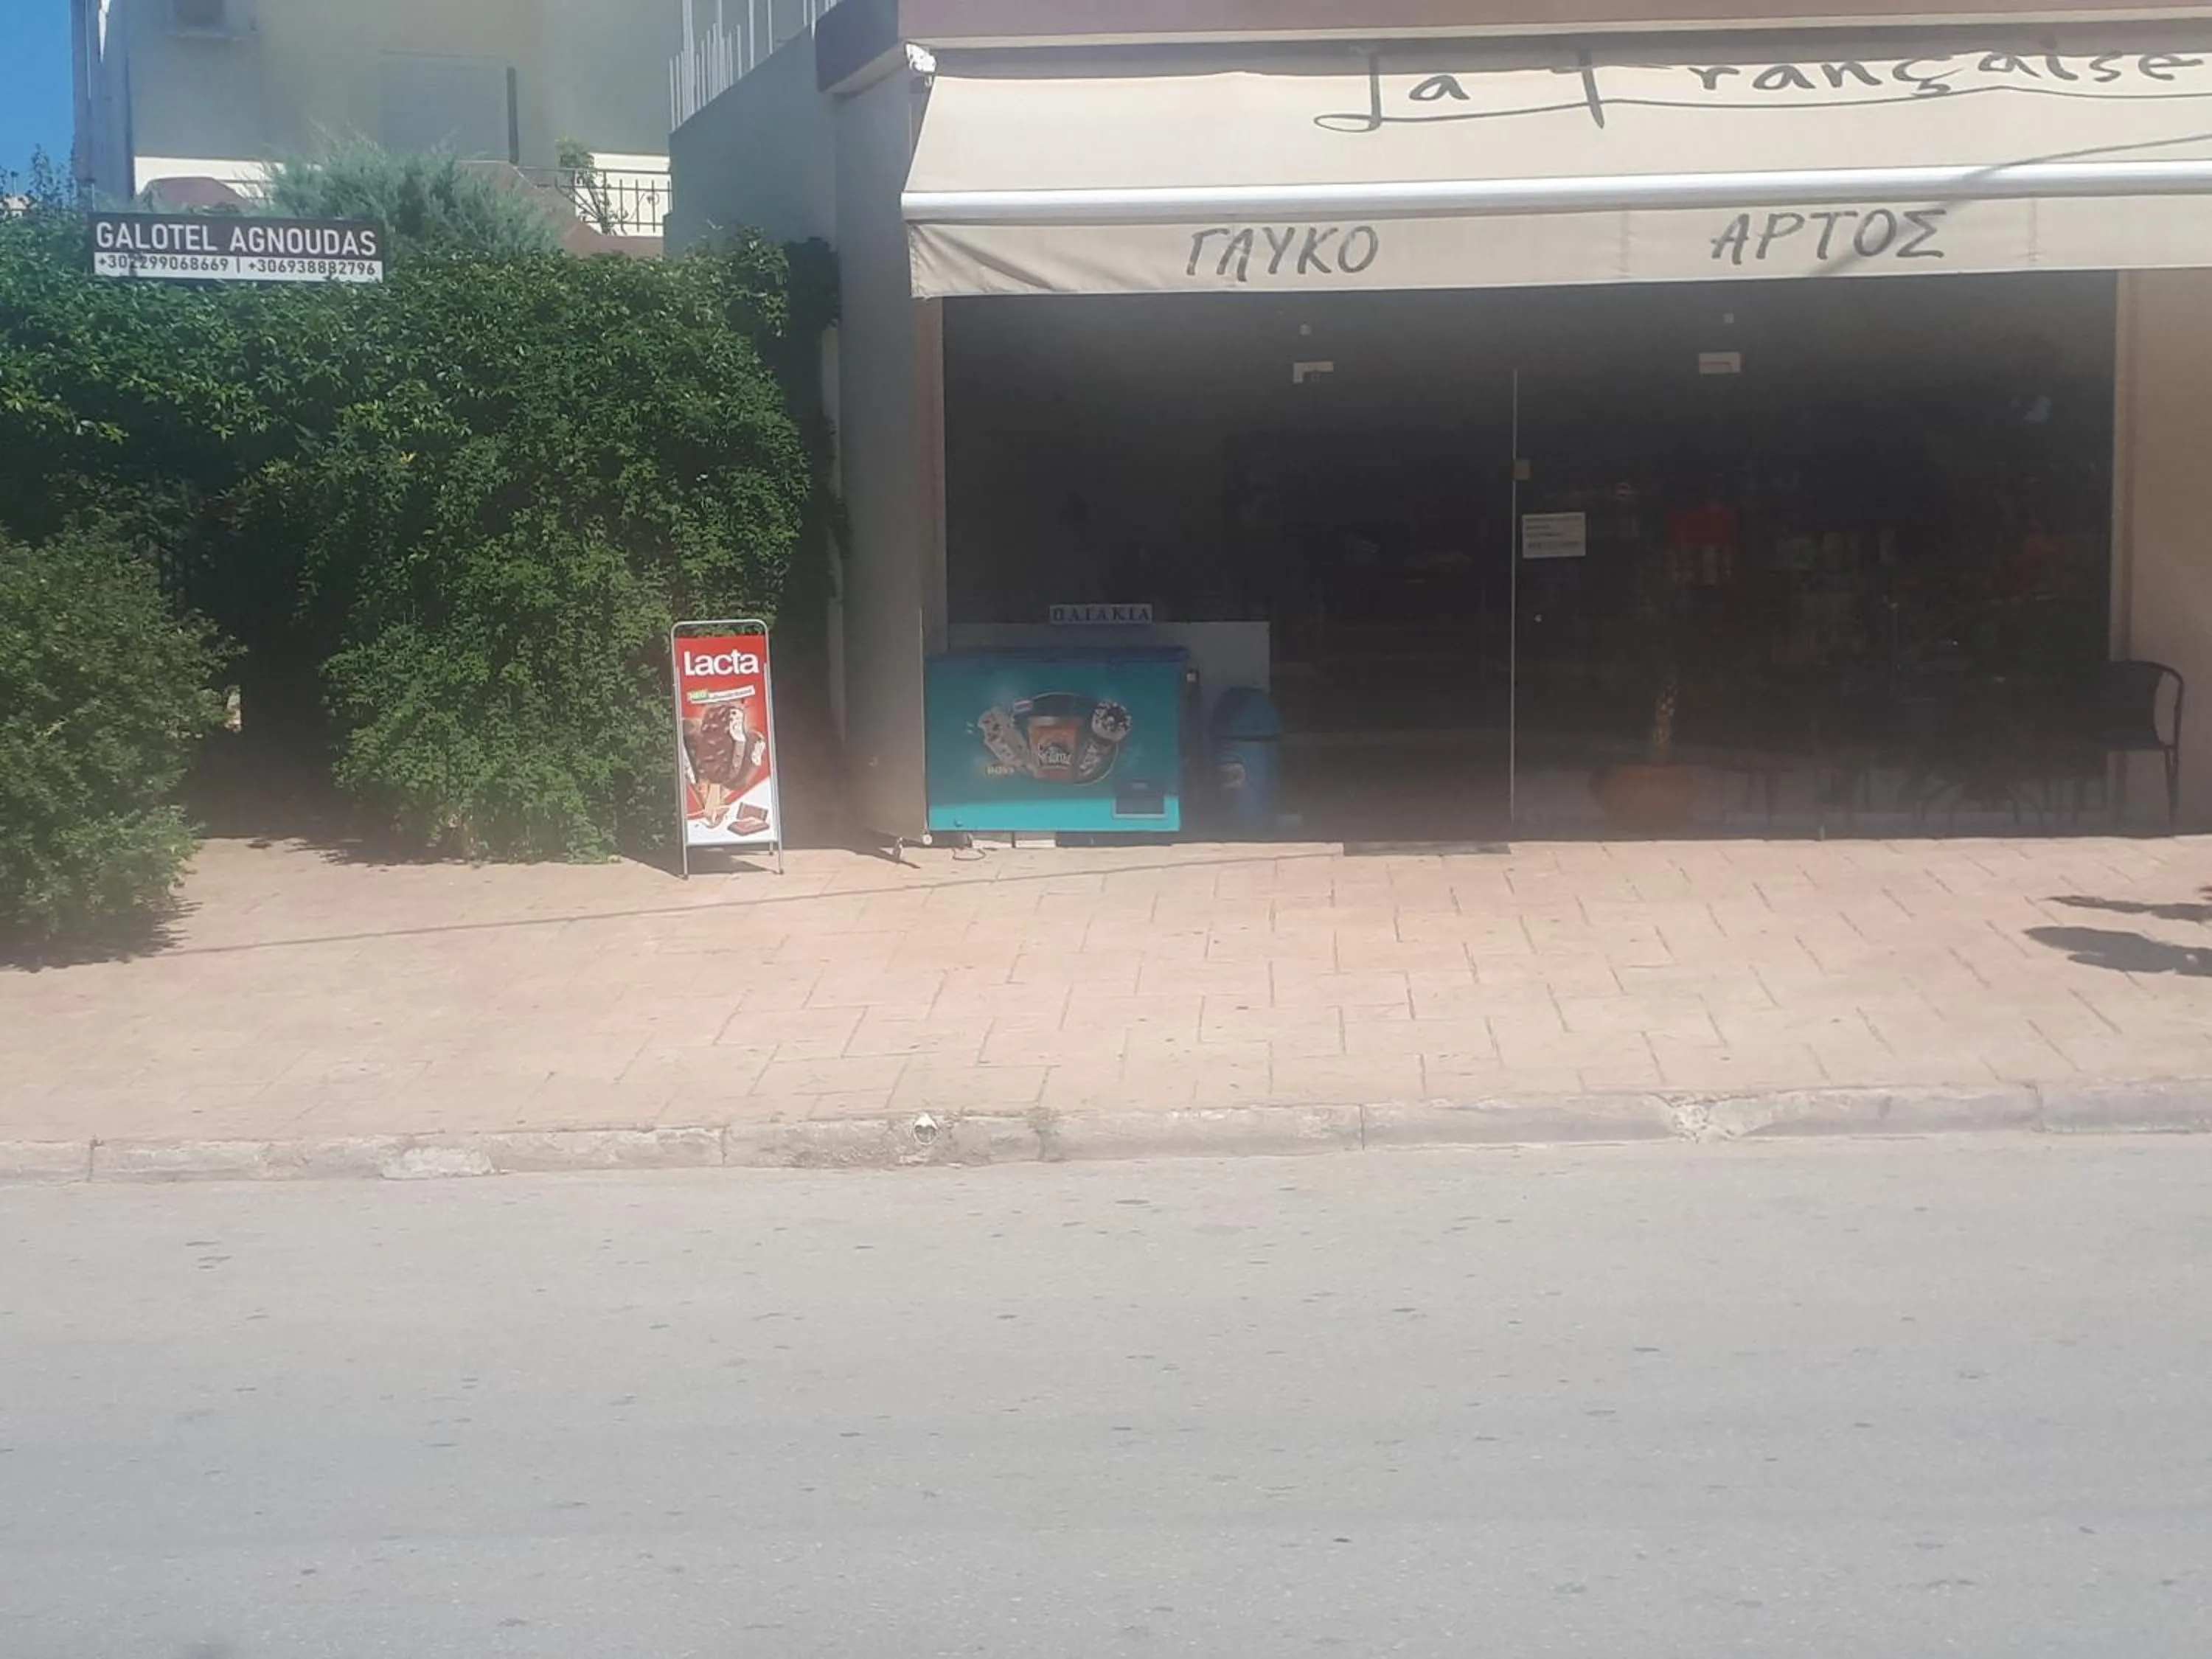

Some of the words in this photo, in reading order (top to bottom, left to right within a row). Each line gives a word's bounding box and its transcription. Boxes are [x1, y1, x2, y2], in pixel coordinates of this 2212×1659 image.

[96, 221, 218, 251] GALOTEL
[229, 226, 377, 256] AGNOUDAS
[1710, 208, 1947, 265] ΑΡΤΟΣ
